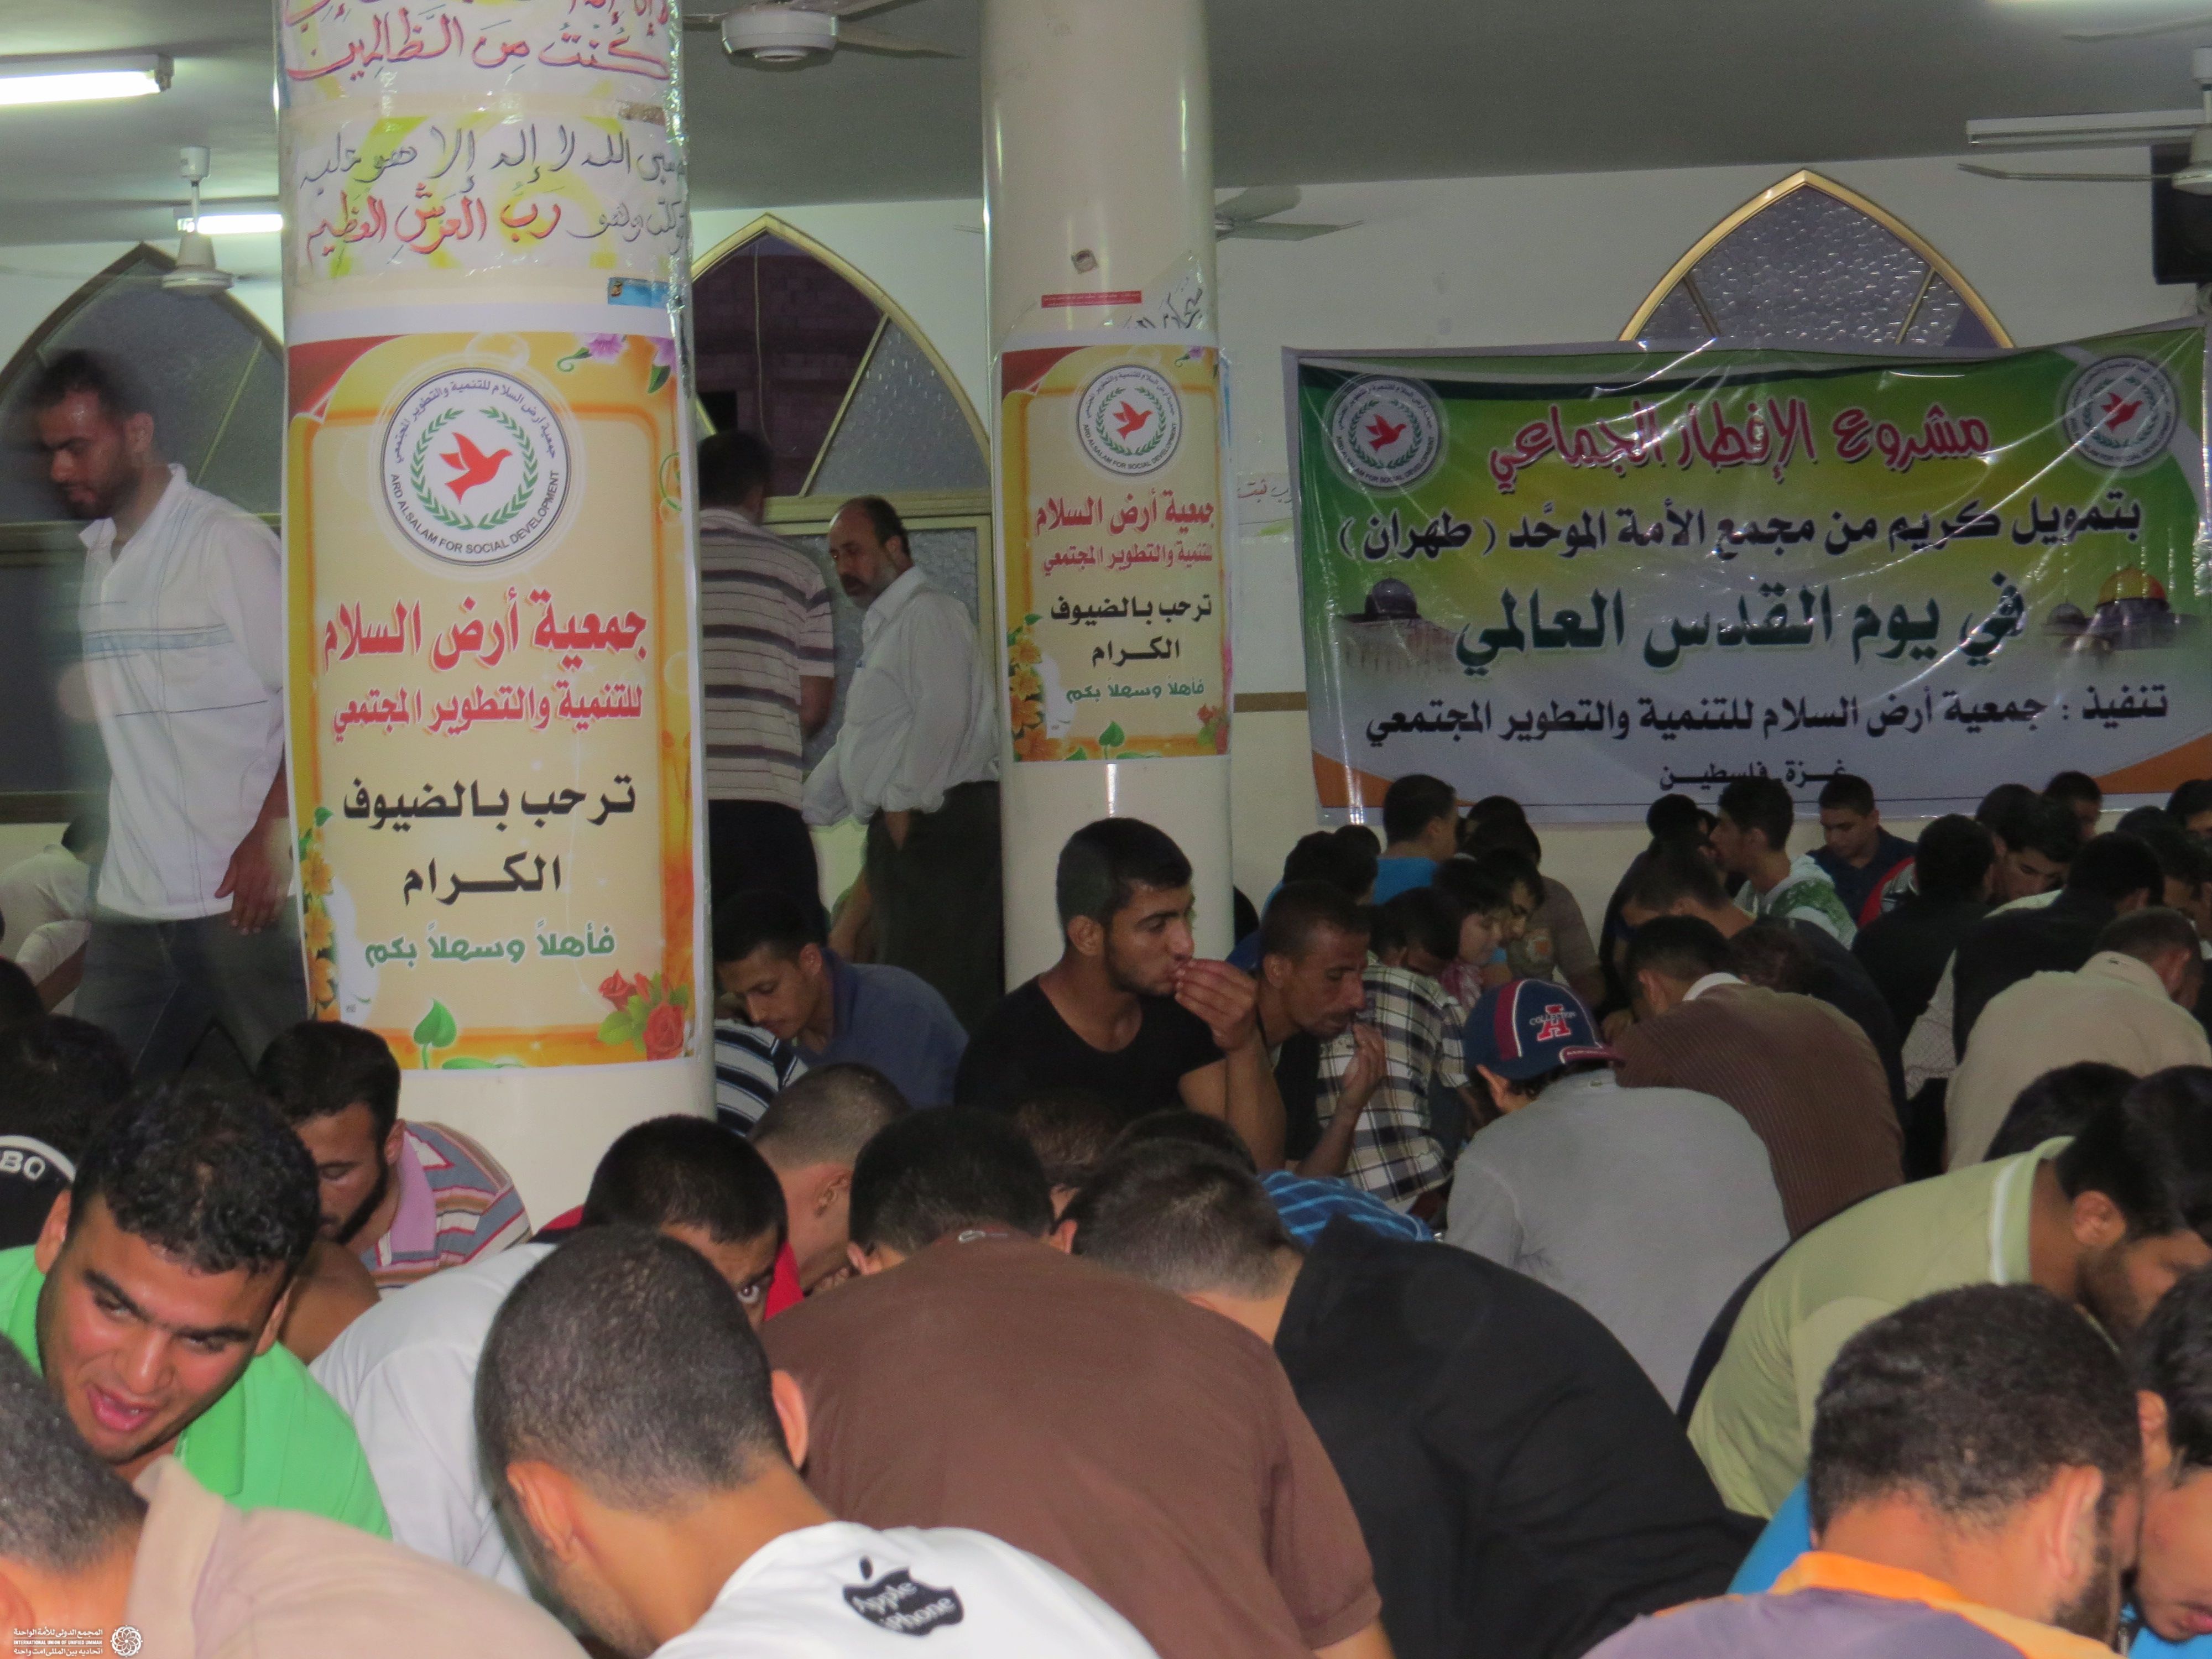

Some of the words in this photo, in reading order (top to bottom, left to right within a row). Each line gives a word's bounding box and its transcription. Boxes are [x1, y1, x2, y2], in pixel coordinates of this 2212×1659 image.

[1486, 397, 1666, 494] الجماعي
[1676, 396, 1818, 484] الإفطار
[1832, 403, 1991, 473] مشروع
[1112, 460, 1126, 469] FOR
[390, 473, 404, 498] ARD
[398, 499, 439, 545] ALSALAM
[438, 538, 463, 553] FOR
[465, 539, 510, 554] SOCIAL
[509, 470, 560, 545] DEVELOPMENT
[1035, 495, 1103, 536] السلام
[1109, 488, 1157, 535] أرض
[1162, 489, 1215, 535] جمعية
[1615, 498, 1705, 547] الأمة
[1824, 509, 1877, 555] من
[1888, 498, 2002, 554] كريم
[2010, 488, 2143, 546] بتمويل
[1042, 544, 1103, 577] المجتمعي
[1107, 542, 1174, 572] والتطوير
[1715, 515, 1815, 560] مجمع
[431, 586, 520, 671] أرض
[529, 587, 649, 671] جمعية
[1050, 595, 1154, 627] بالضيوف
[1159, 593, 1213, 623] ترحب
[1453, 586, 1626, 677] العالمي
[1643, 582, 1833, 670] القدس
[1852, 597, 1941, 665] يوم
[1959, 571, 2026, 669] في
[324, 598, 422, 674] السلام
[1091, 635, 1181, 668] الكرام
[333, 685, 422, 743] المجتمعي
[426, 683, 551, 735] والتطوير
[555, 679, 643, 731] للتنمية
[1066, 684, 1101, 704] بكم
[1639, 696, 1755, 742] للتنمية
[1762, 695, 1859, 739] السلام
[1866, 686, 1933, 738] أرض
[1942, 688, 2048, 734] جمعية
[2081, 684, 2169, 729] تنفيذ
[1365, 698, 1493, 749] المجتمعي
[1498, 698, 1630, 744] والتطوير
[343, 777, 510, 832] بالضيوف
[520, 774, 636, 830] ترحب
[402, 850, 562, 907] الكرام
[364, 935, 417, 969] بكم
